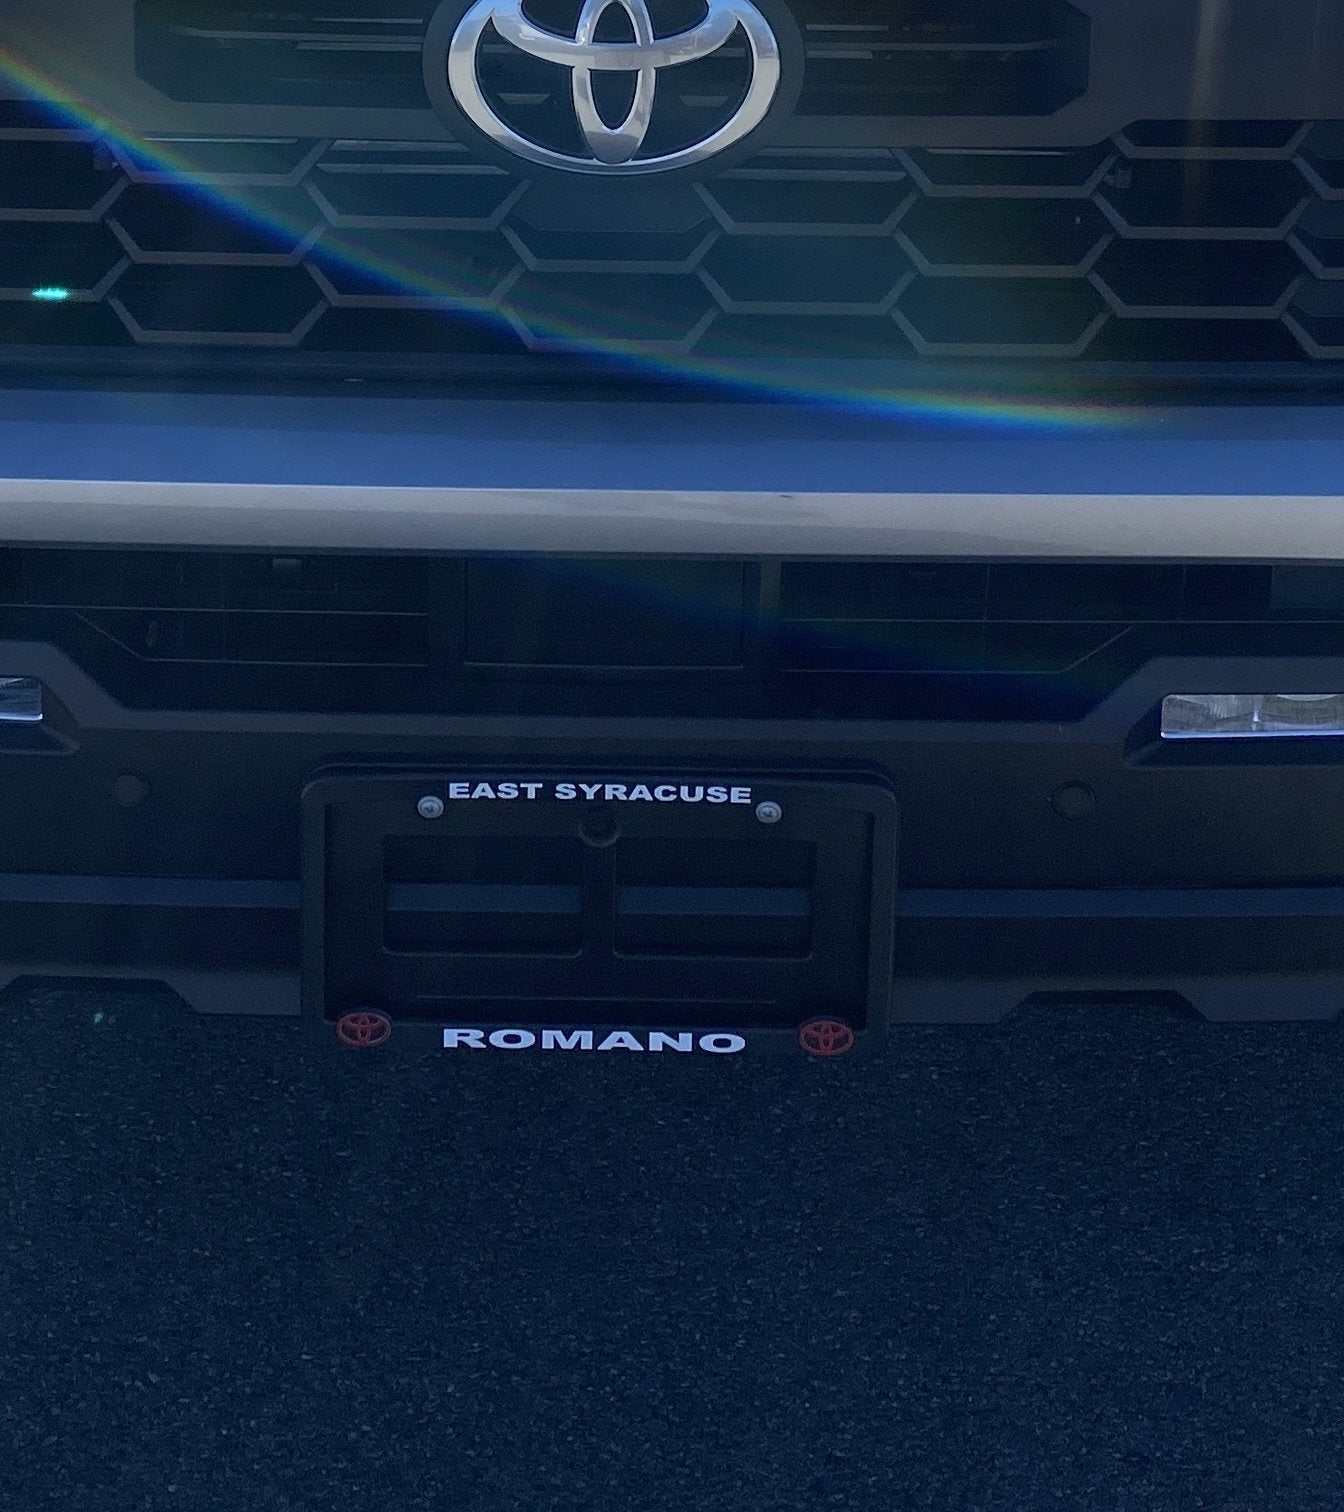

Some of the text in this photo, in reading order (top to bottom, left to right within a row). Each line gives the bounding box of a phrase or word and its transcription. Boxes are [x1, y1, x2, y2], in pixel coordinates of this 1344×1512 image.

[448, 782, 752, 804] EAST SYRACUSE
[443, 1028, 746, 1053] ROMANO
